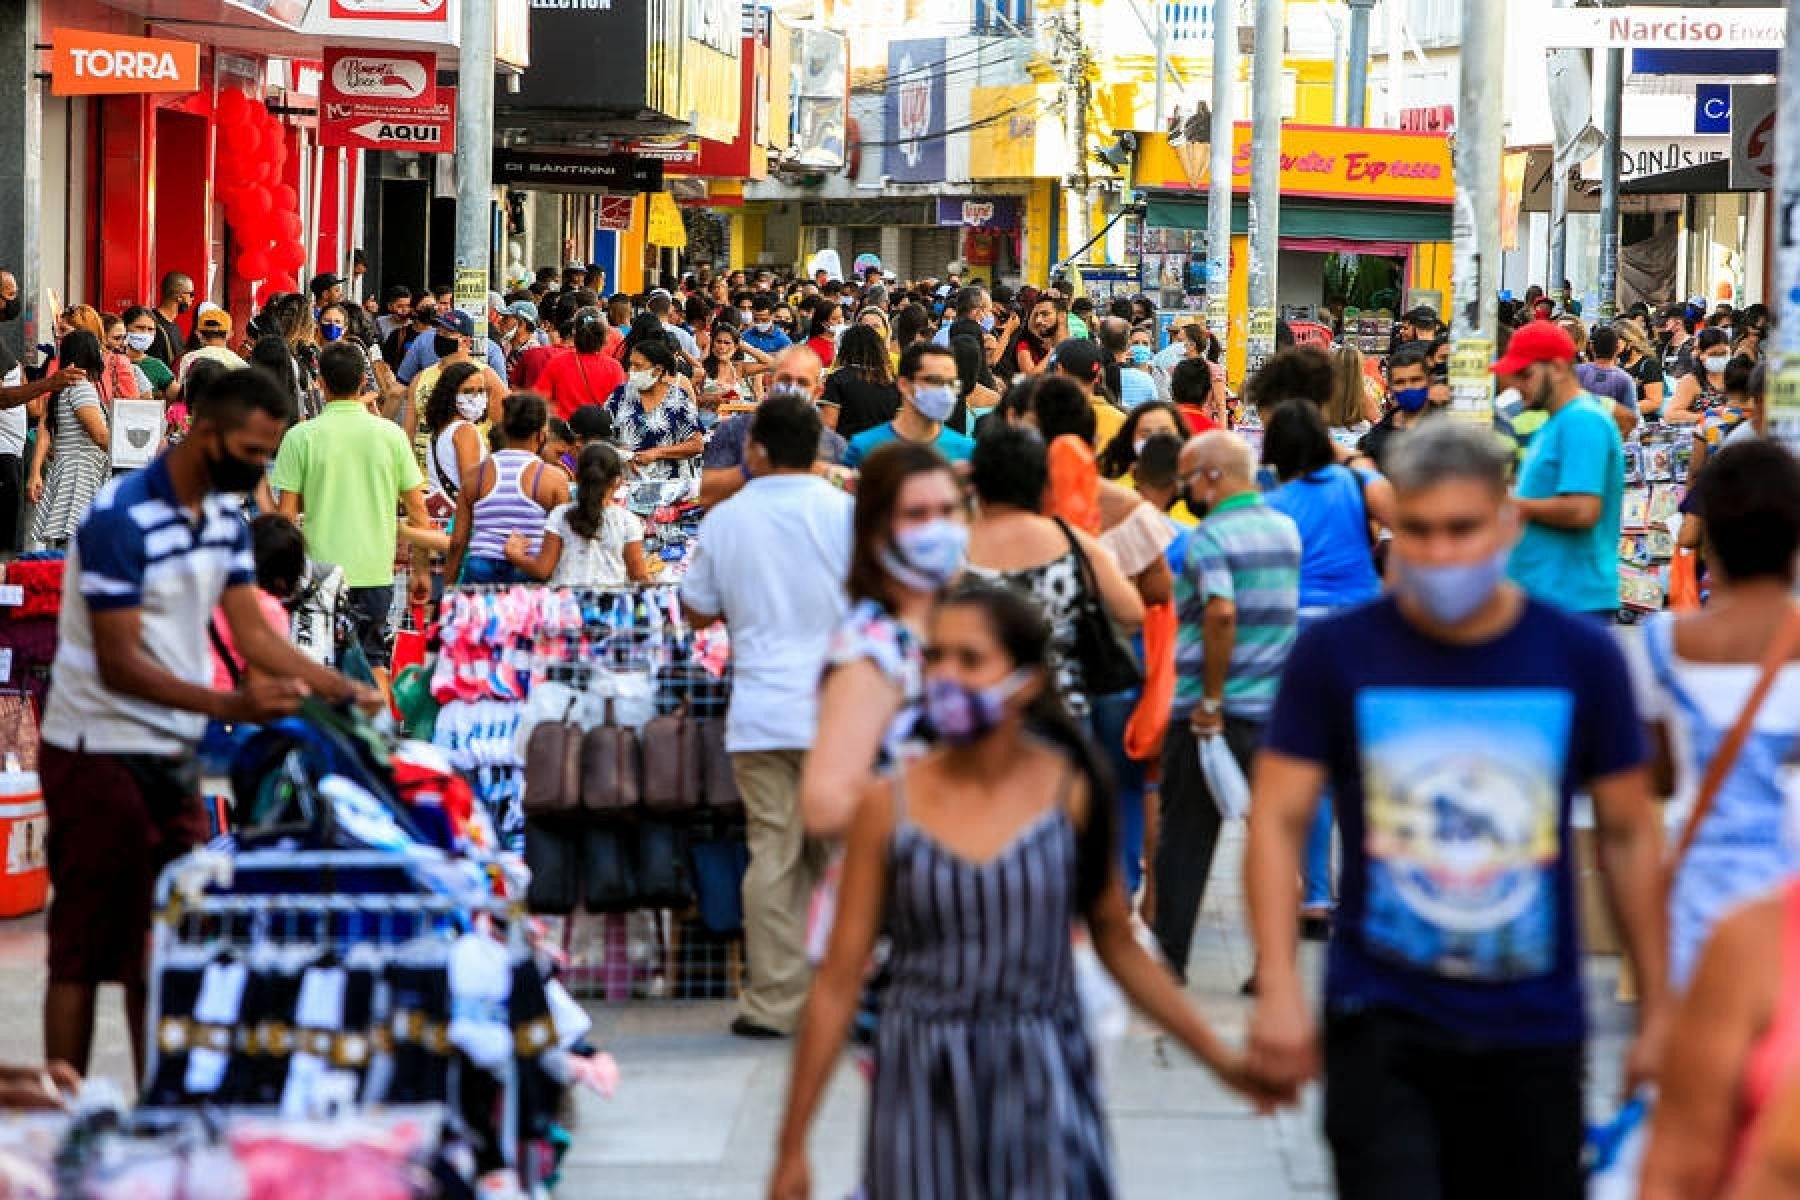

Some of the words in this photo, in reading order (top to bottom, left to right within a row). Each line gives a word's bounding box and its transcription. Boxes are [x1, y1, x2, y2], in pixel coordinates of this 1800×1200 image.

[1609, 15, 1724, 42] Narciso
[69, 48, 180, 81] TORRA
[378, 124, 437, 141] AQUI
[1231, 142, 1334, 175] Svetes
[1343, 152, 1441, 184] Expresso
